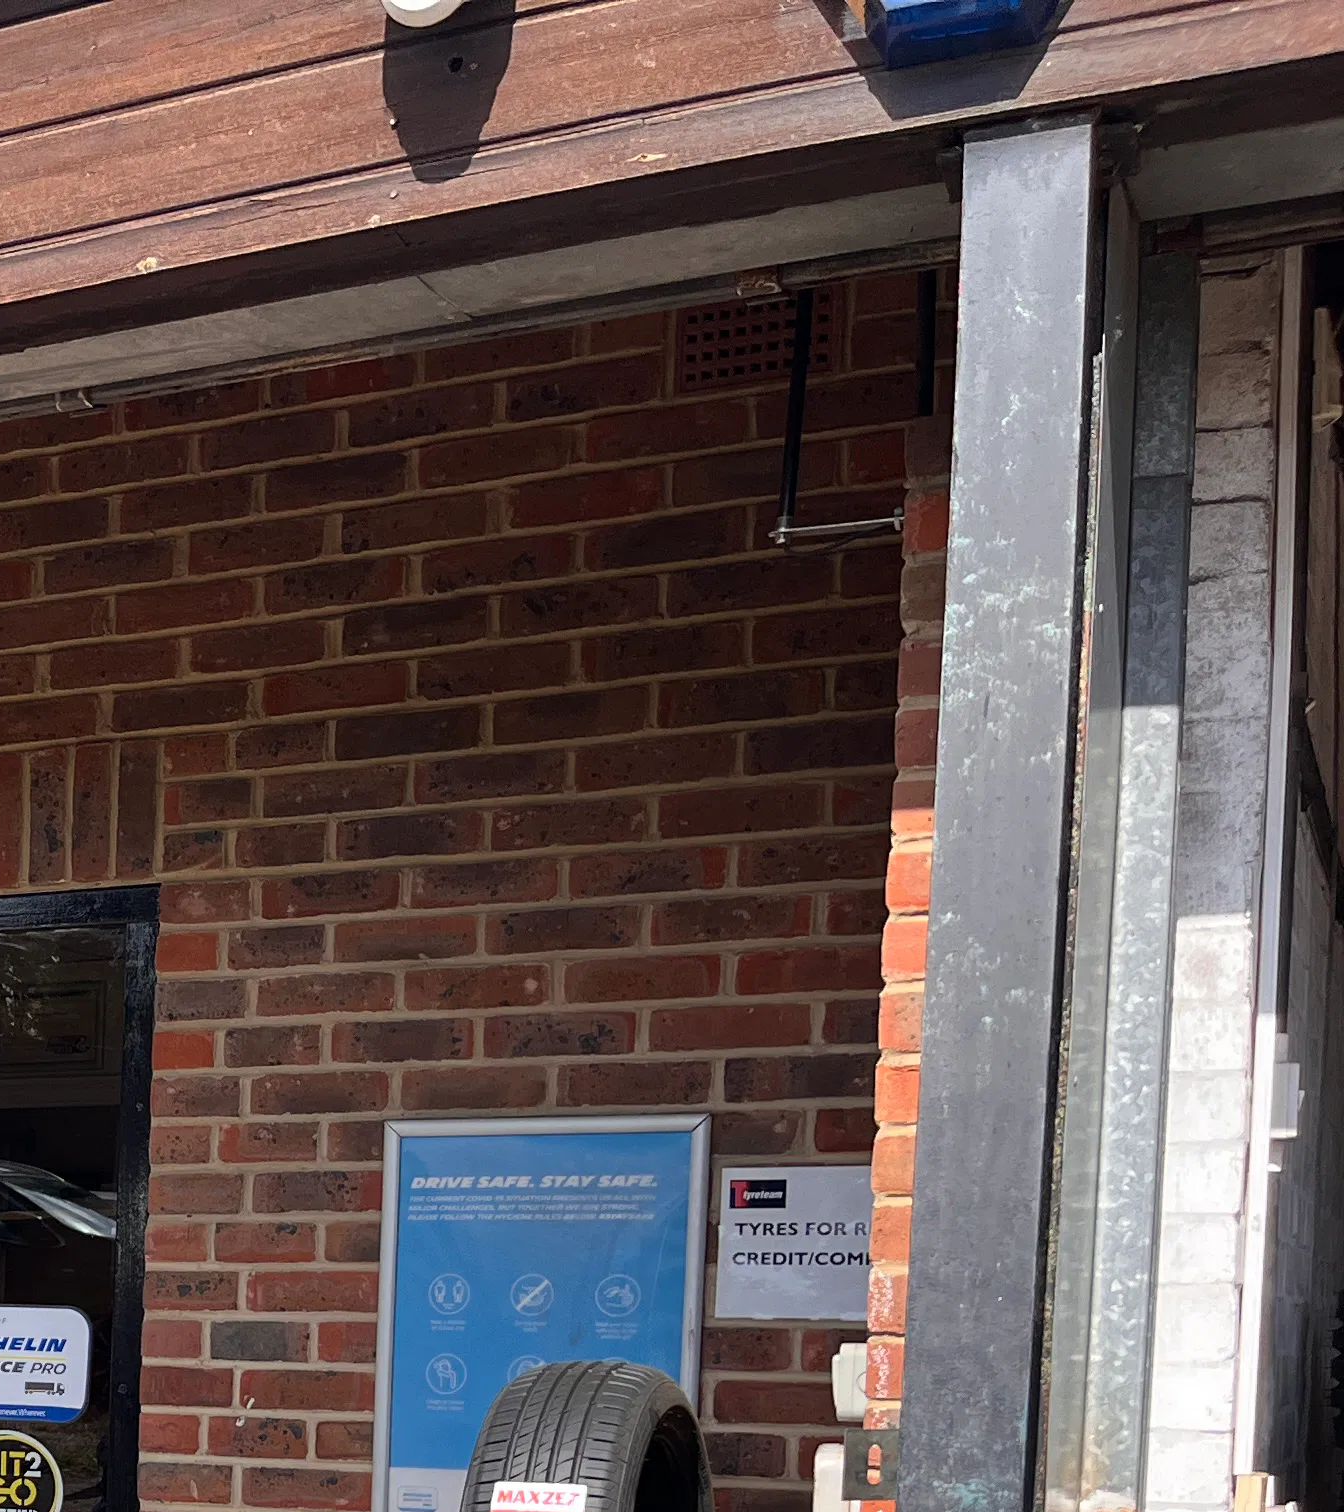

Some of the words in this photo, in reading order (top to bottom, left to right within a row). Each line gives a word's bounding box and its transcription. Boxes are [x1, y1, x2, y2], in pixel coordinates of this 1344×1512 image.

[410, 1176, 475, 1189] DRIVE
[476, 1175, 535, 1189] SAFE.
[539, 1175, 596, 1188] STAY
[597, 1175, 658, 1188] SAFE.
[734, 1222, 798, 1236] TYRES
[805, 1222, 846, 1236] FOR
[29, 1362, 67, 1375] PRO
